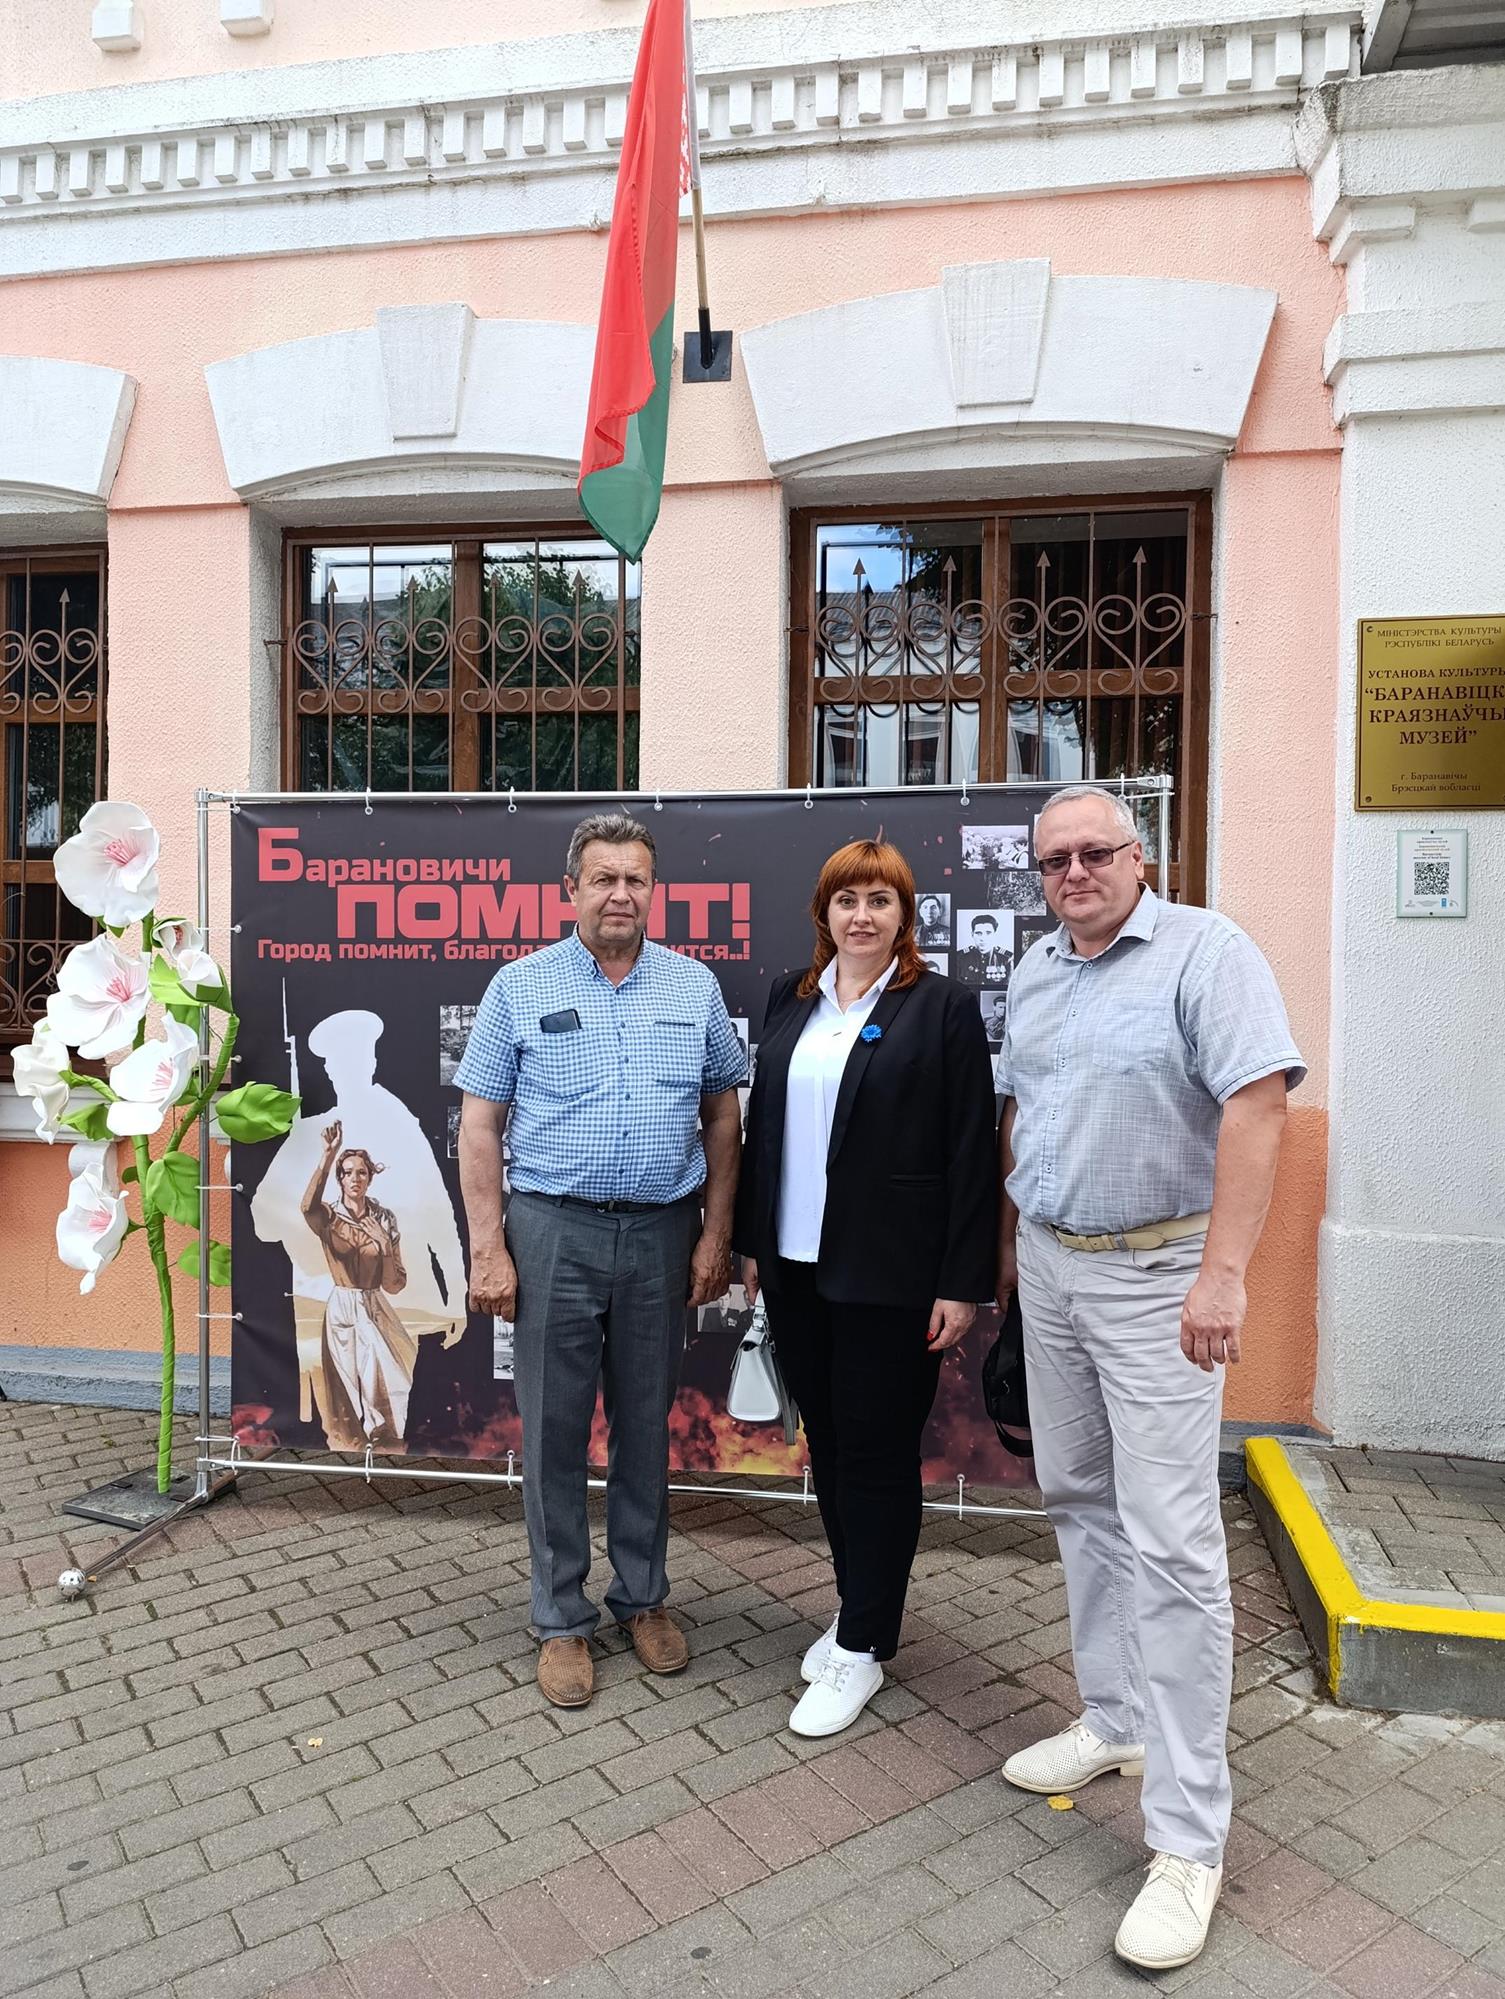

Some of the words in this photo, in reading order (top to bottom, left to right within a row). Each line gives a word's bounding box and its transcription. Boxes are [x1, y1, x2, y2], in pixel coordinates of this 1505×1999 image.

[1377, 628, 1446, 638] МІНІСТЭРСТВА
[1450, 626, 1502, 636] КУЛЬТУРЫ
[1385, 639, 1441, 648] РЭСПУБЛІКІ
[1445, 638, 1495, 647] БЕЛАРУСЬ
[1368, 669, 1435, 679] УСТАНОВА
[1399, 726, 1477, 745] МУЗЕЙ”
[1411, 771, 1468, 783] Баранавічы
[1391, 783, 1436, 795] Брэсцкай
[1439, 782, 1481, 792] вобласці
[257, 827, 511, 888] Барановичи
[257, 939, 332, 963] Город
[338, 943, 437, 962] помнит,
